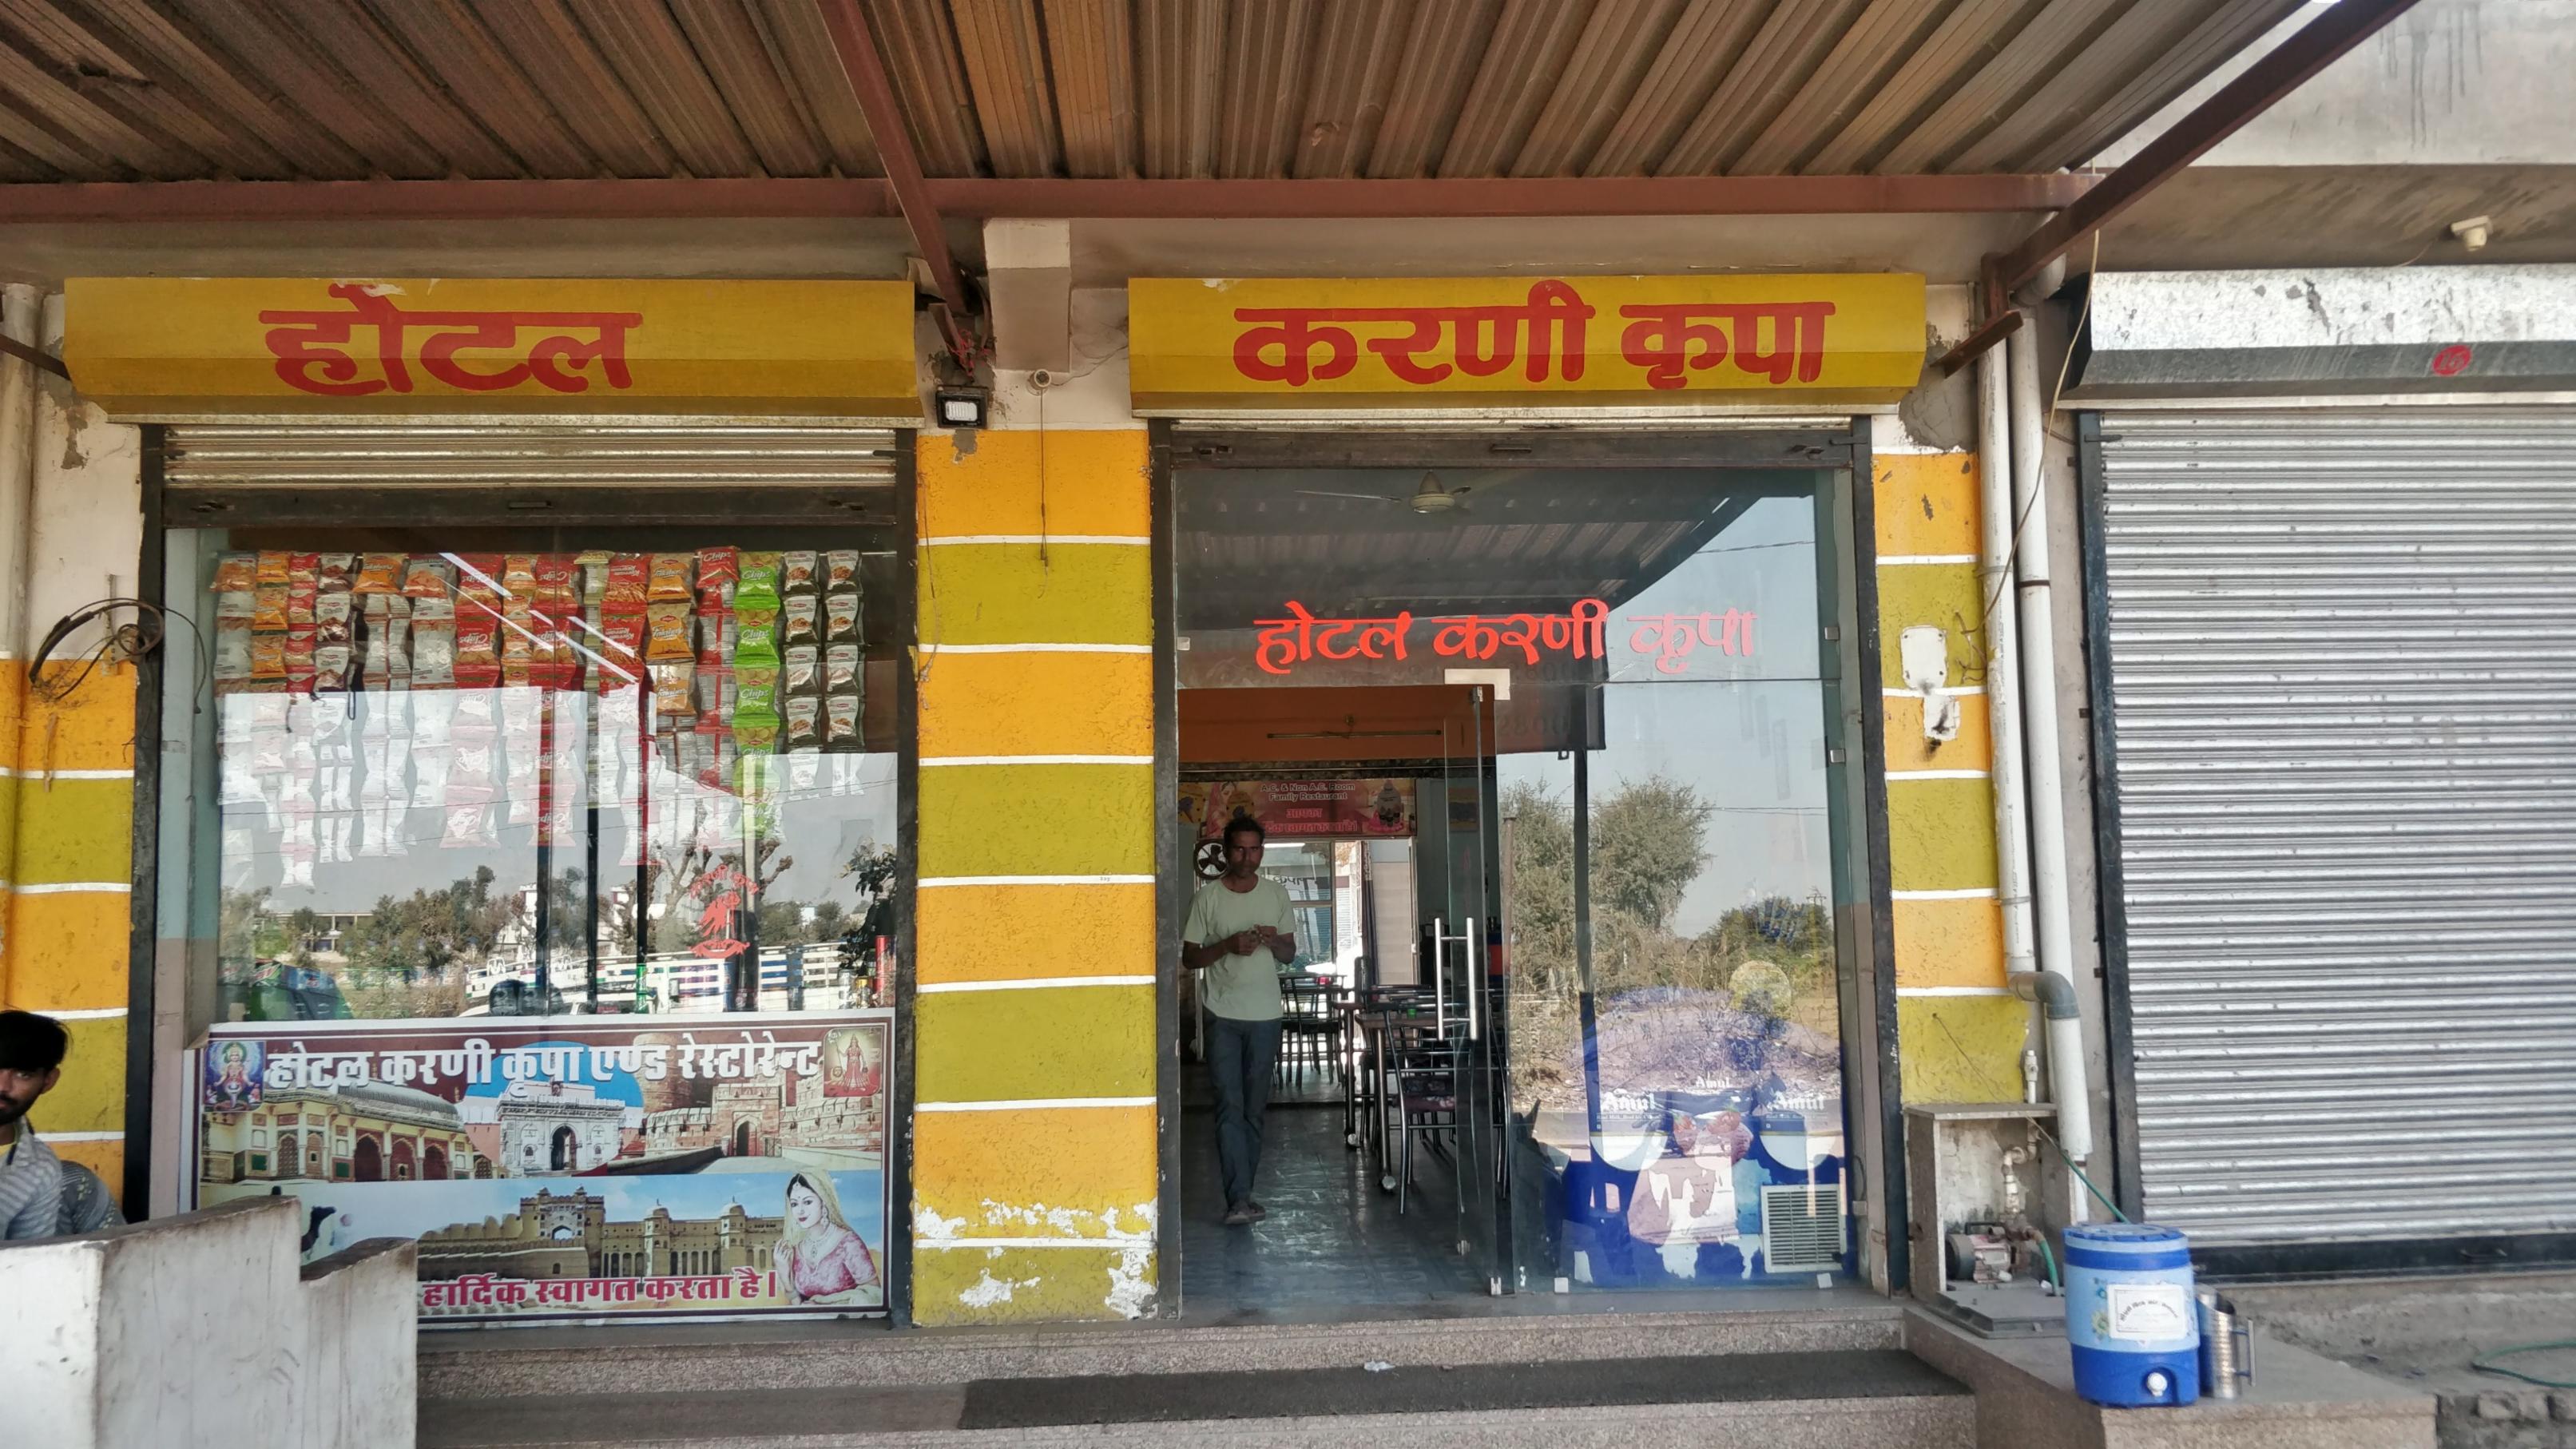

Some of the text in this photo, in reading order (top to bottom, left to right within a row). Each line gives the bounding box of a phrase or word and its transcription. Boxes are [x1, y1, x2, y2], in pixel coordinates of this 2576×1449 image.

[259, 284, 643, 396] होटल
[1233, 280, 1836, 390] करणी कृपा
[741, 629, 770, 641] Chips
[1254, 598, 1757, 674] होटल करणी कृपा
[740, 689, 768, 700] Chips
[1268, 792, 1348, 802] Family Restaurant
[1289, 783, 1308, 792] Non
[1329, 782, 1355, 792] Room
[266, 1030, 822, 1098] होटल करणी कृपा एण्ड रेस्टोरेन्ट
[423, 1272, 527, 1307] हार्दिक
[534, 1277, 639, 1304] स्वागत
[644, 1275, 733, 1300] करता
